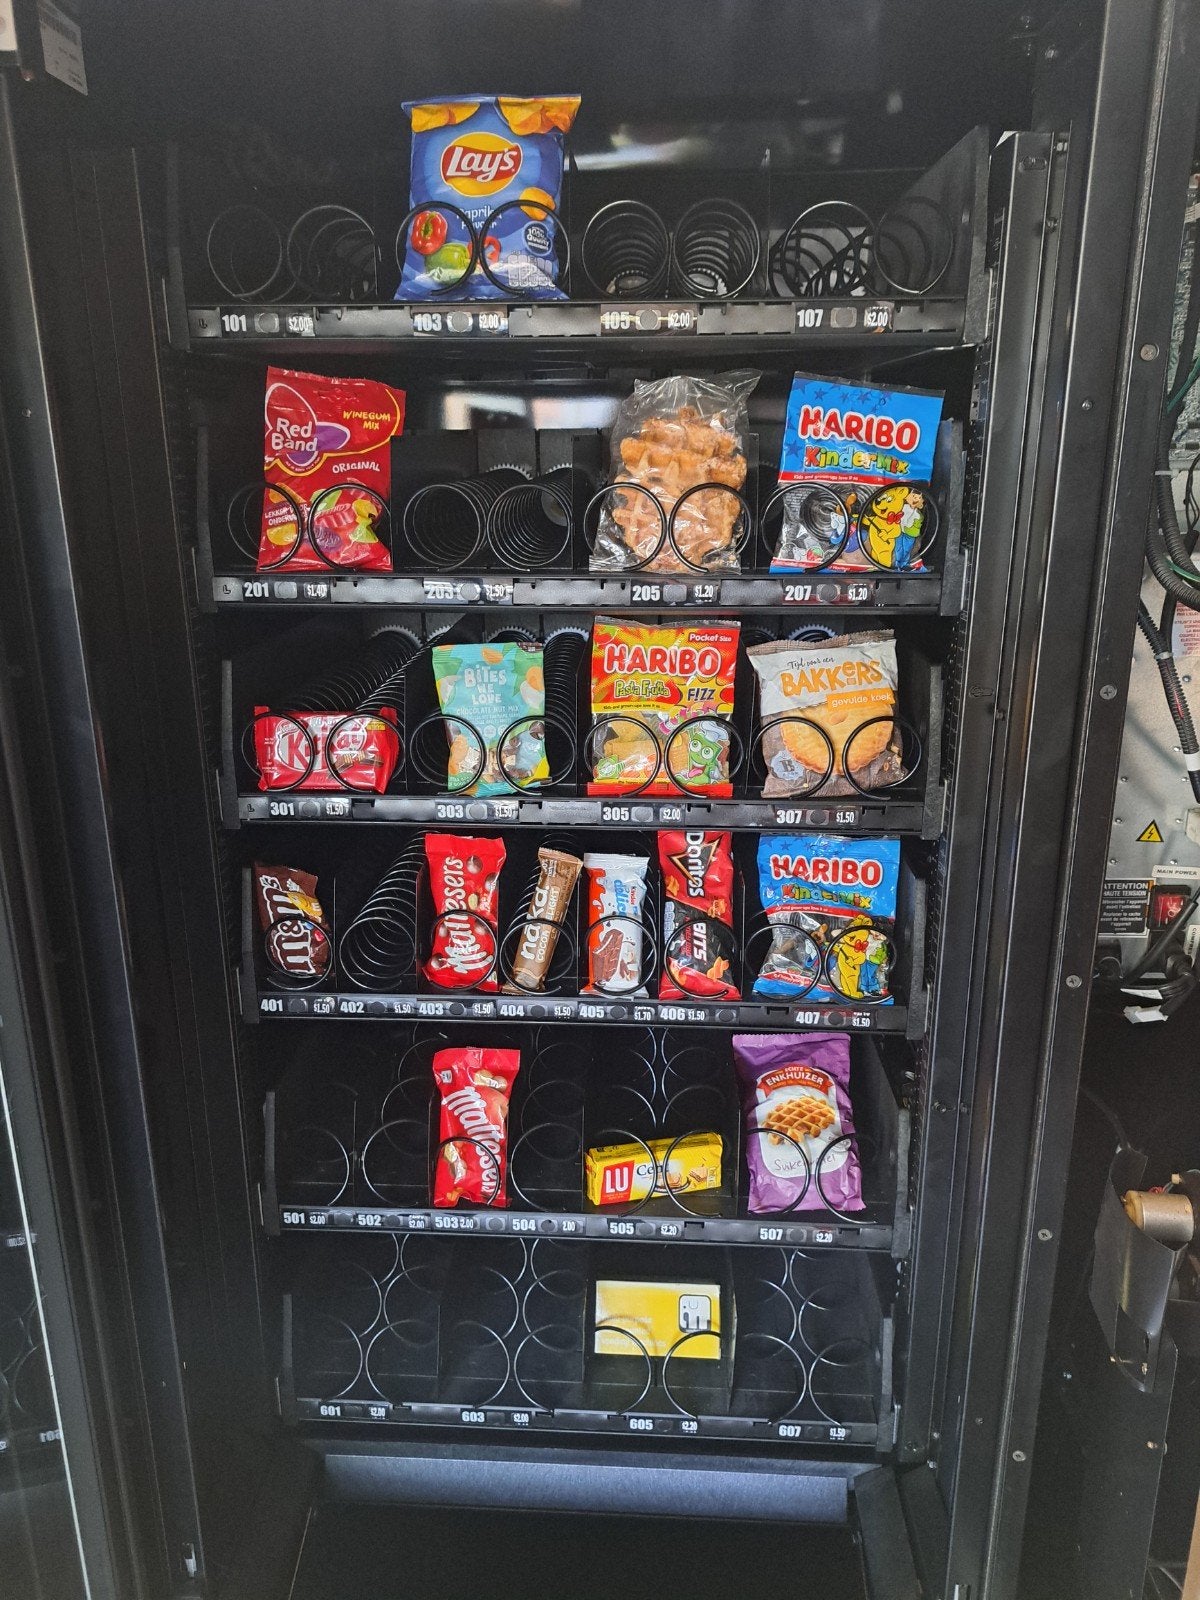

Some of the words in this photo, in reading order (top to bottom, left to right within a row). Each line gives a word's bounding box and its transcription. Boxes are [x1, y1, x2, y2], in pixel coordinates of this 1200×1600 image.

[446, 147, 517, 182] Lay's
[222, 314, 247, 332] 101
[414, 314, 442, 332] 103
[603, 312, 631, 330] 105
[670, 312, 690, 328] $2.00
[797, 309, 824, 328] 107
[867, 311, 888, 327] $2.00
[343, 410, 391, 422] WINEGUM
[276, 417, 312, 438] Red
[363, 421, 379, 430] MIX
[799, 406, 919, 452] HARIBO
[271, 433, 318, 452] Band
[332, 461, 381, 474] ORIGINAL
[244, 582, 269, 598] 201
[632, 585, 660, 601] 205
[695, 585, 714, 598] $1.20
[785, 585, 812, 601] 207
[848, 587, 867, 600] $1.20
[689, 633, 719, 642] Pocket
[604, 645, 721, 677] HARIBO
[787, 657, 806, 669] Tijd
[476, 683, 494, 694] WE
[615, 680, 640, 698] Pasta
[471, 693, 502, 705] LOVE
[831, 694, 868, 707] gevulde
[870, 693, 892, 702] koek
[270, 802, 295, 816] 301
[326, 803, 344, 816] $1.50
[437, 804, 464, 819] 303
[603, 807, 629, 821] 305
[663, 808, 681, 820] $2.00
[776, 809, 803, 824] 307
[836, 811, 854, 823] $1.50
[686, 831, 705, 897] Doritos
[769, 854, 883, 887] HARIBO
[546, 887, 560, 921] ELIGHT
[693, 922, 707, 962] BITS
[260, 999, 283, 1012] 401
[313, 1002, 330, 1014] $1.50
[340, 1001, 365, 1014] 402
[394, 1002, 411, 1014] $1.50
[419, 1002, 445, 1016] 403
[474, 1003, 491, 1015] $1.50
[500, 1004, 525, 1017] 404
[554, 1005, 571, 1017] $1.50
[579, 1005, 605, 1018] 405
[634, 1010, 651, 1021] $1.70
[660, 1007, 686, 1021] 406
[688, 1009, 705, 1021] $1.50
[795, 1011, 820, 1024] 407
[851, 1016, 870, 1027] $1.50
[766, 1071, 824, 1086] ENKHUIZER
[774, 1154, 836, 1171] Suikeel
[605, 1166, 629, 1194] LU
[283, 1212, 305, 1224] 501
[310, 1215, 326, 1225] $2.00
[358, 1214, 382, 1227] 502
[435, 1216, 459, 1229] 503
[512, 1218, 536, 1231] 504
[610, 1222, 635, 1235] 505
[760, 1228, 783, 1241] 507
[320, 1405, 341, 1416] 601
[461, 1410, 485, 1422] 603
[629, 1418, 653, 1430] 605
[779, 1425, 802, 1437] 607
